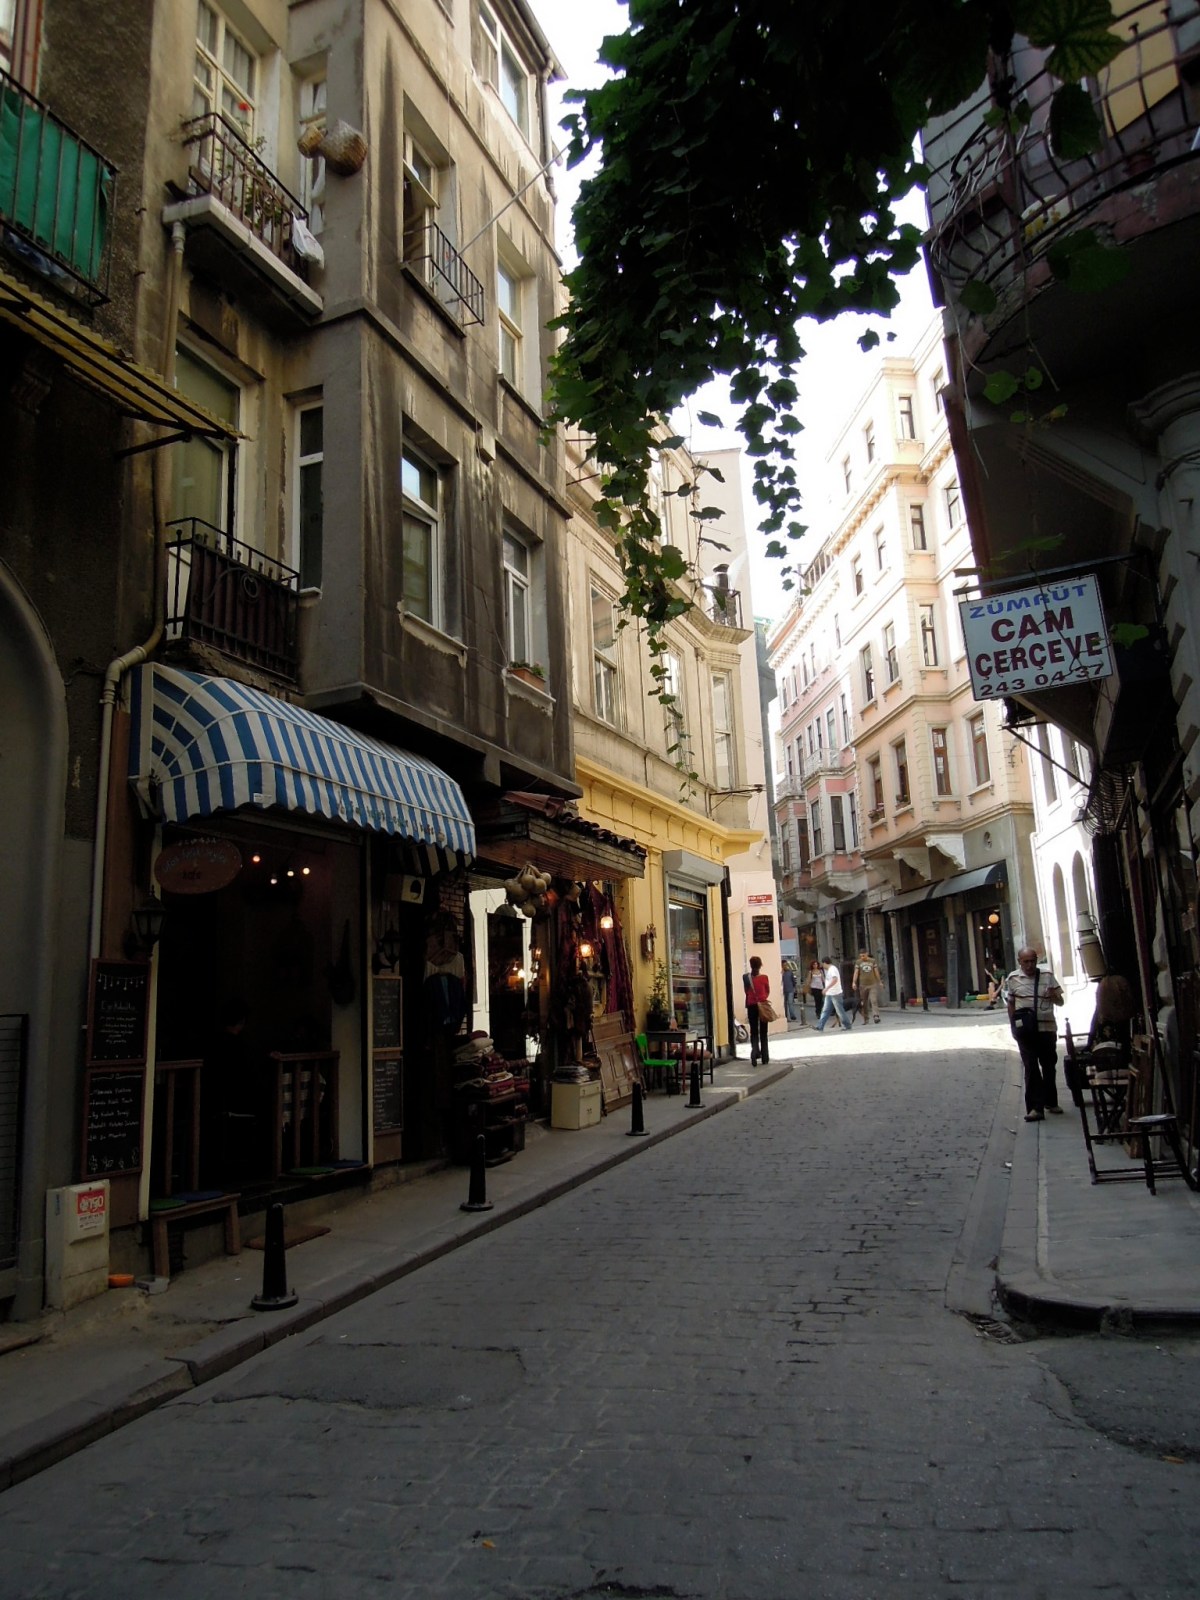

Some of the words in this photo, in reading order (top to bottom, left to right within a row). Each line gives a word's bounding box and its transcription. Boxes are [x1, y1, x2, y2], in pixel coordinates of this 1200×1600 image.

[970, 584, 1087, 618] ZÜMRÜT
[991, 607, 1074, 642] CAM
[975, 632, 1102, 680] ÇERÇEVE
[980, 678, 1026, 697] 243
[1035, 671, 1066, 686] 04
